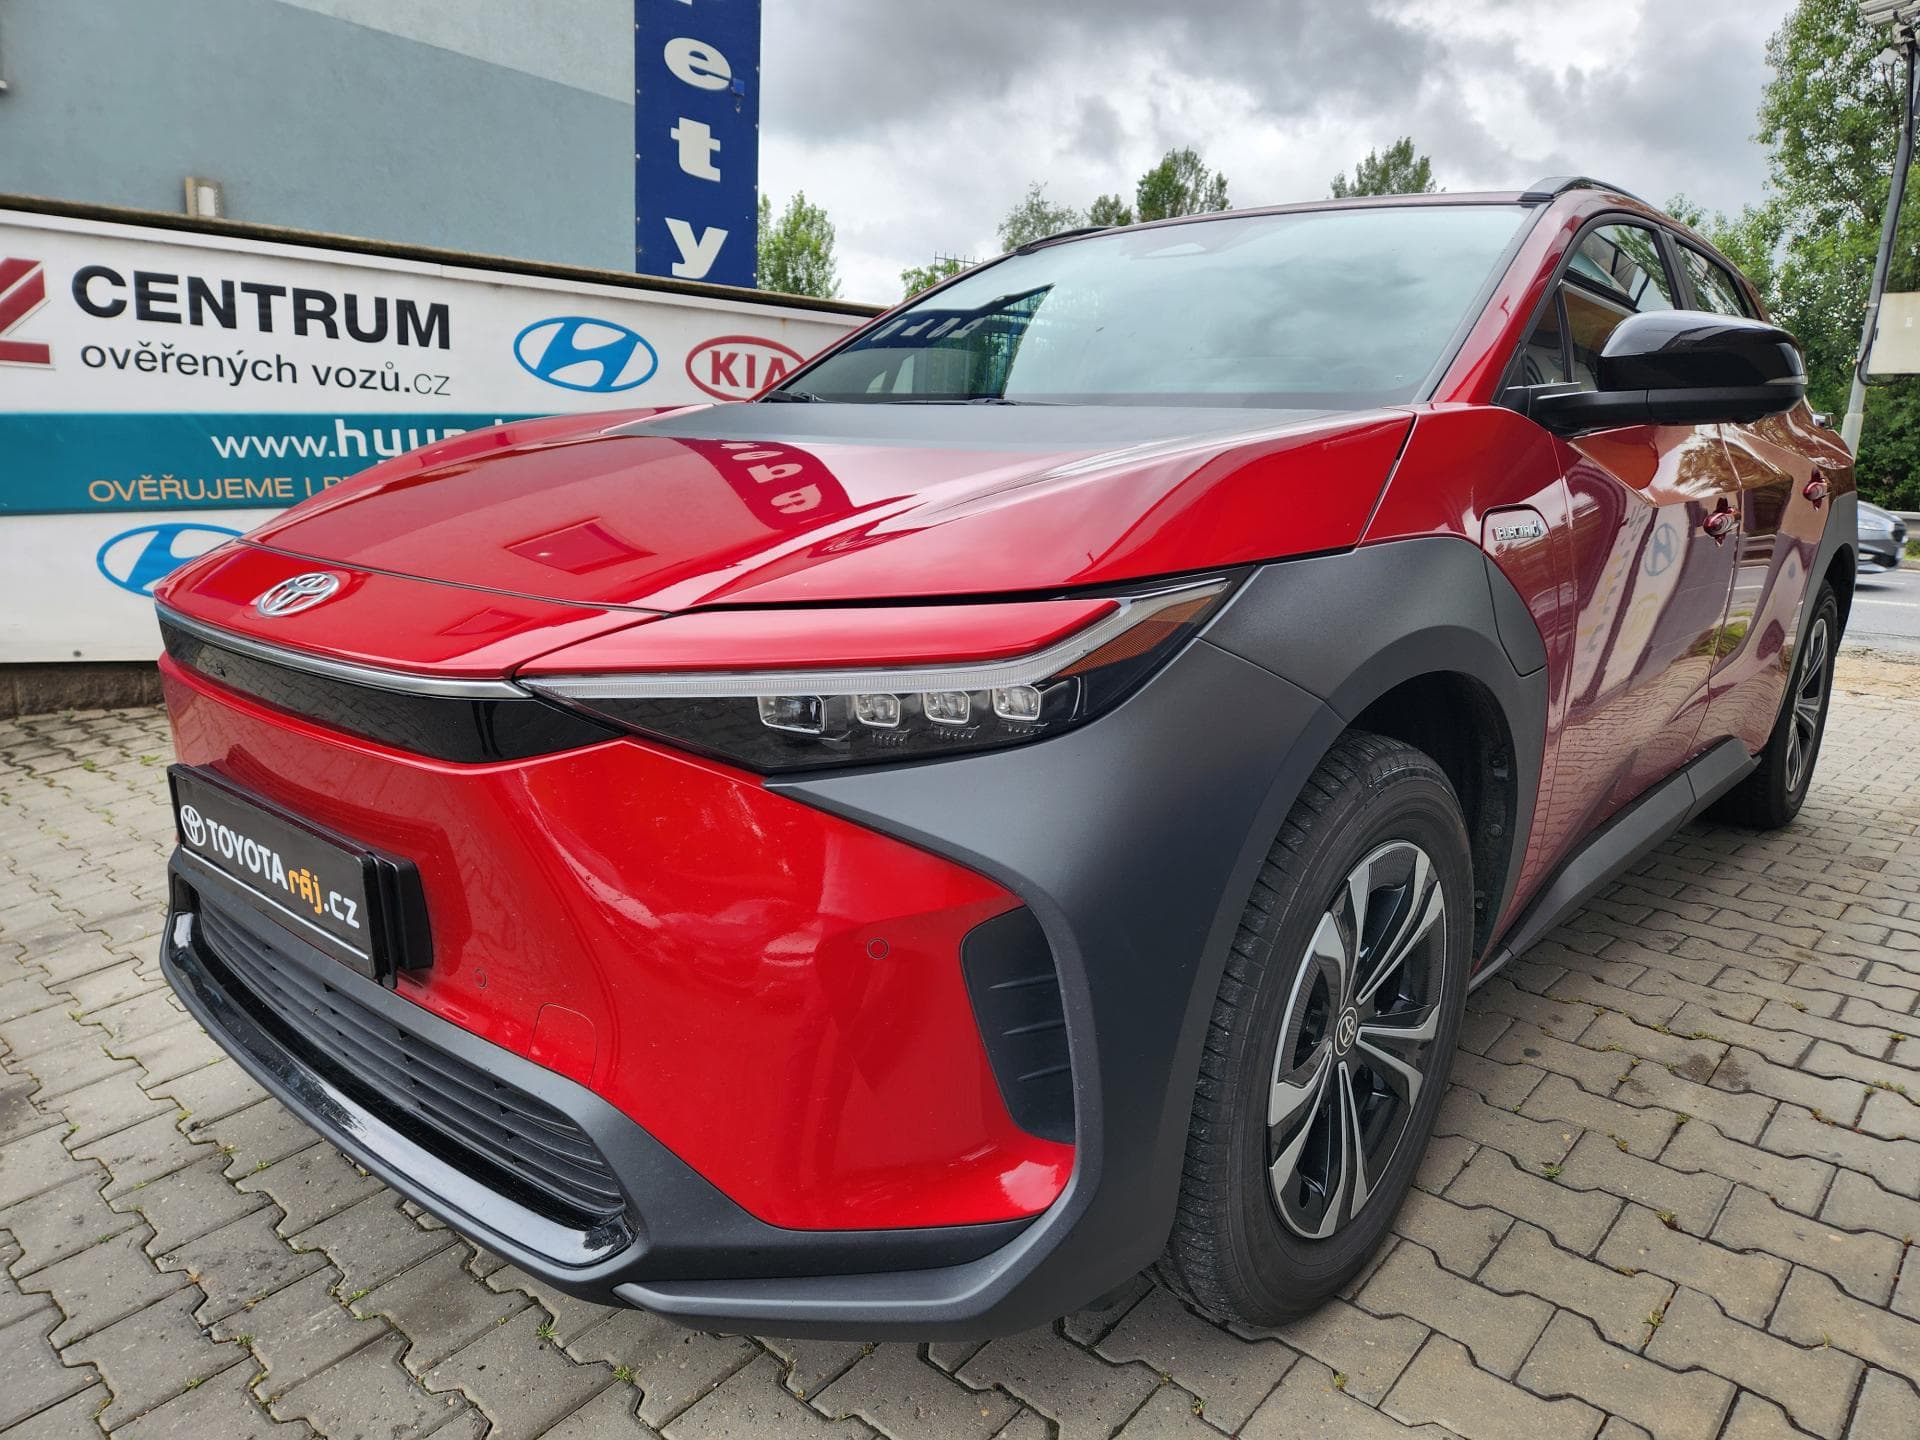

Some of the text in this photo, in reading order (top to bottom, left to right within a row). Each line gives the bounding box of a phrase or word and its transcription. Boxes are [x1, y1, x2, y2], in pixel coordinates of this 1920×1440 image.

[664, 0, 732, 280] ety
[71, 264, 451, 350] CENTRUM
[80, 340, 452, 397] ověřených vozů.cz
[710, 350, 788, 389] KIA
[88, 474, 294, 502] OVĚŘUJEME
